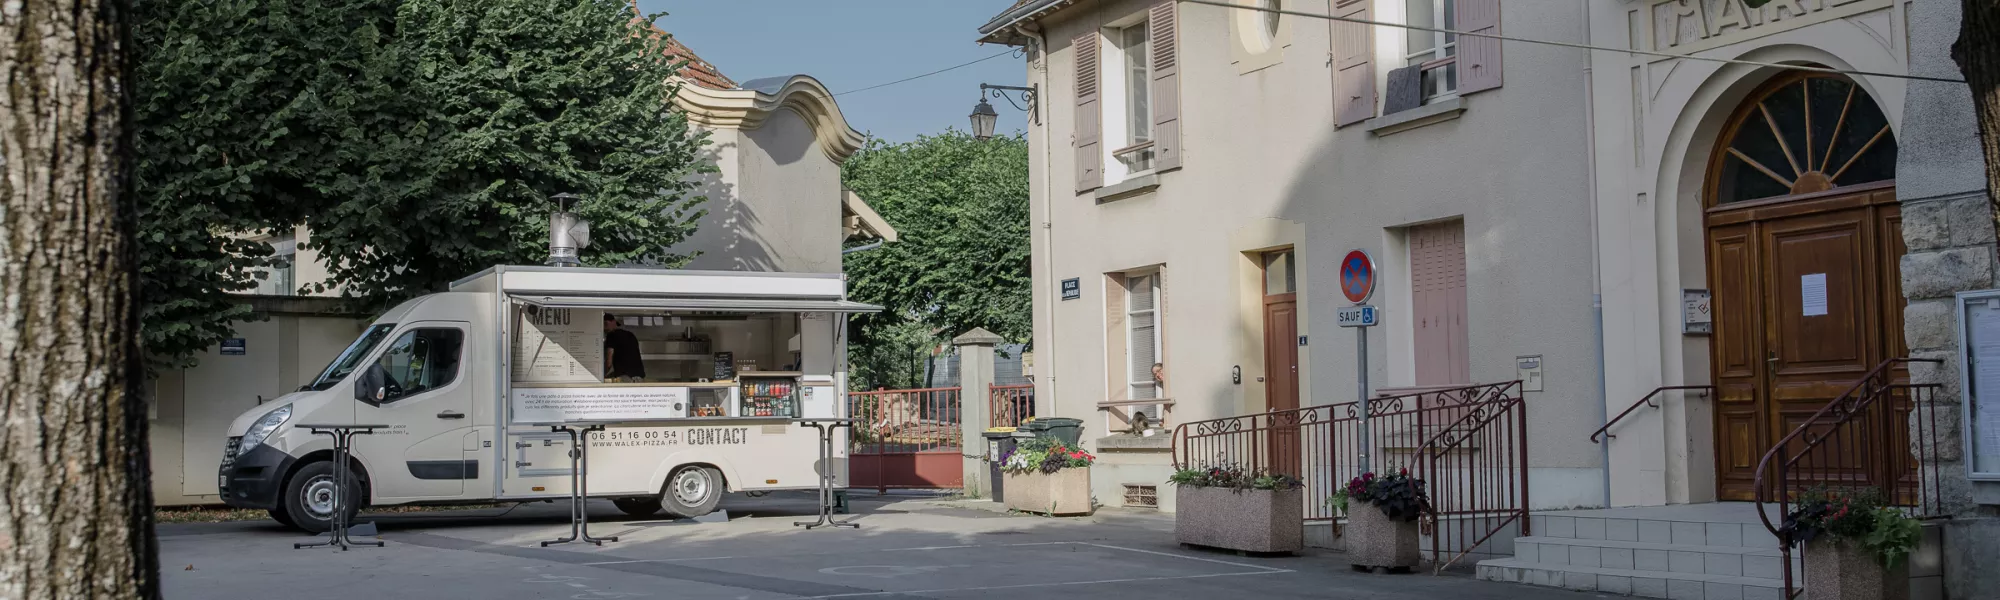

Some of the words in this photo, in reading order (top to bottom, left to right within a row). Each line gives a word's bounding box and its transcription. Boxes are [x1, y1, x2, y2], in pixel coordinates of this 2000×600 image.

[1064, 281, 1076, 289] PLACE
[533, 308, 571, 326] MENU
[1339, 311, 1360, 322] SAUF
[592, 432, 605, 440] 06
[688, 428, 748, 445] CONTACT
